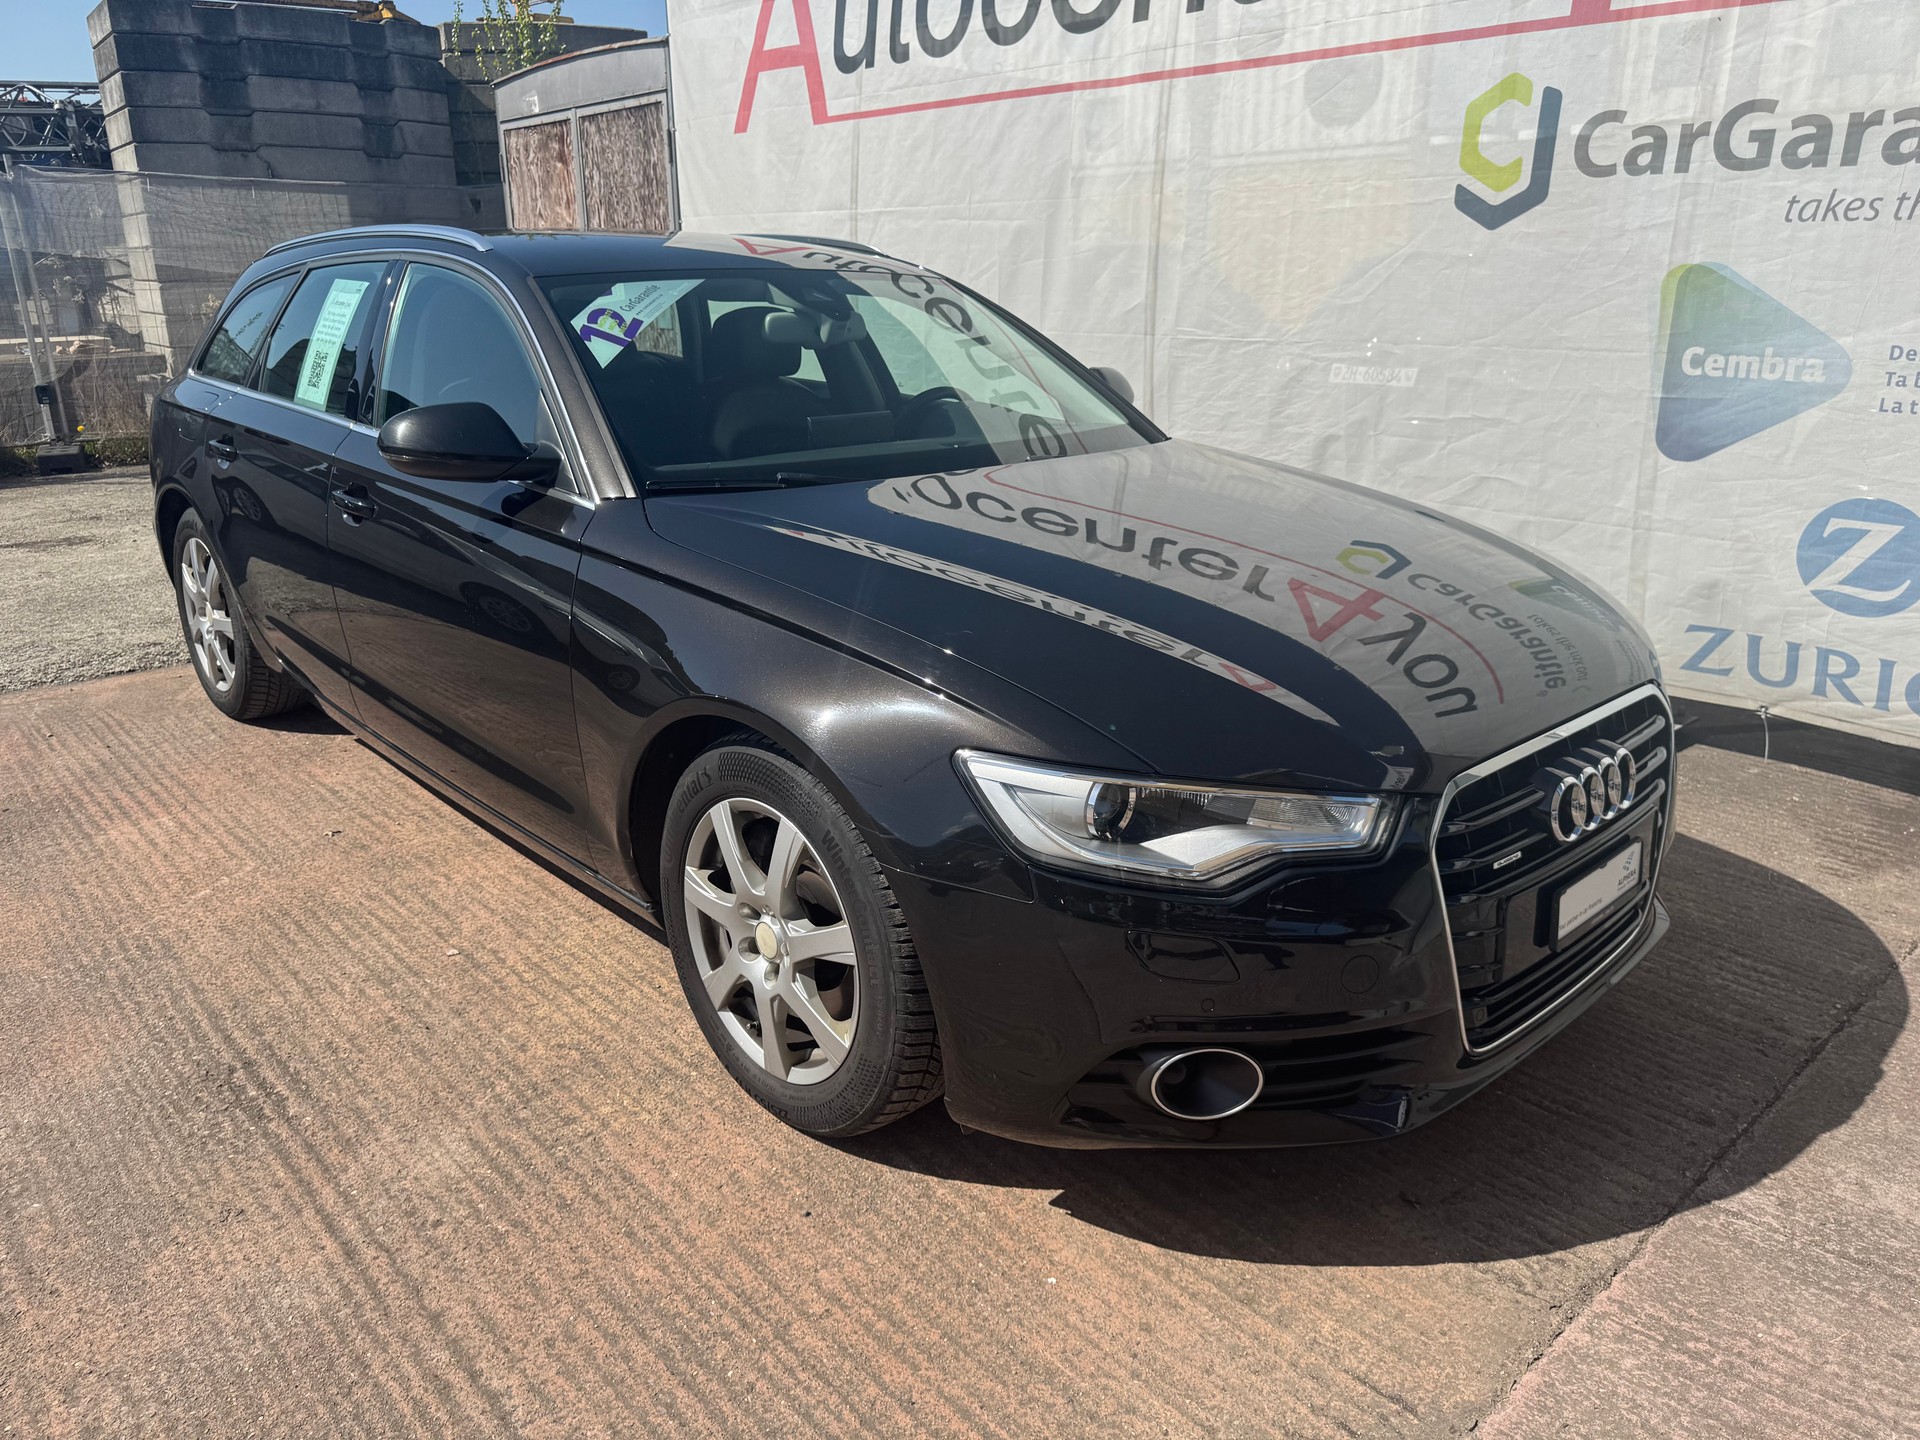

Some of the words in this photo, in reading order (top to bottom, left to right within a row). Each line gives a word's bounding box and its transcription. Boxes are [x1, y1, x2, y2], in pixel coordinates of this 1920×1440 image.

[1784, 188, 1883, 223] takes
[1888, 344, 1920, 362] De
[1680, 345, 1826, 385] Cembra
[1885, 371, 1908, 388] Ta
[1879, 397, 1904, 414] La
